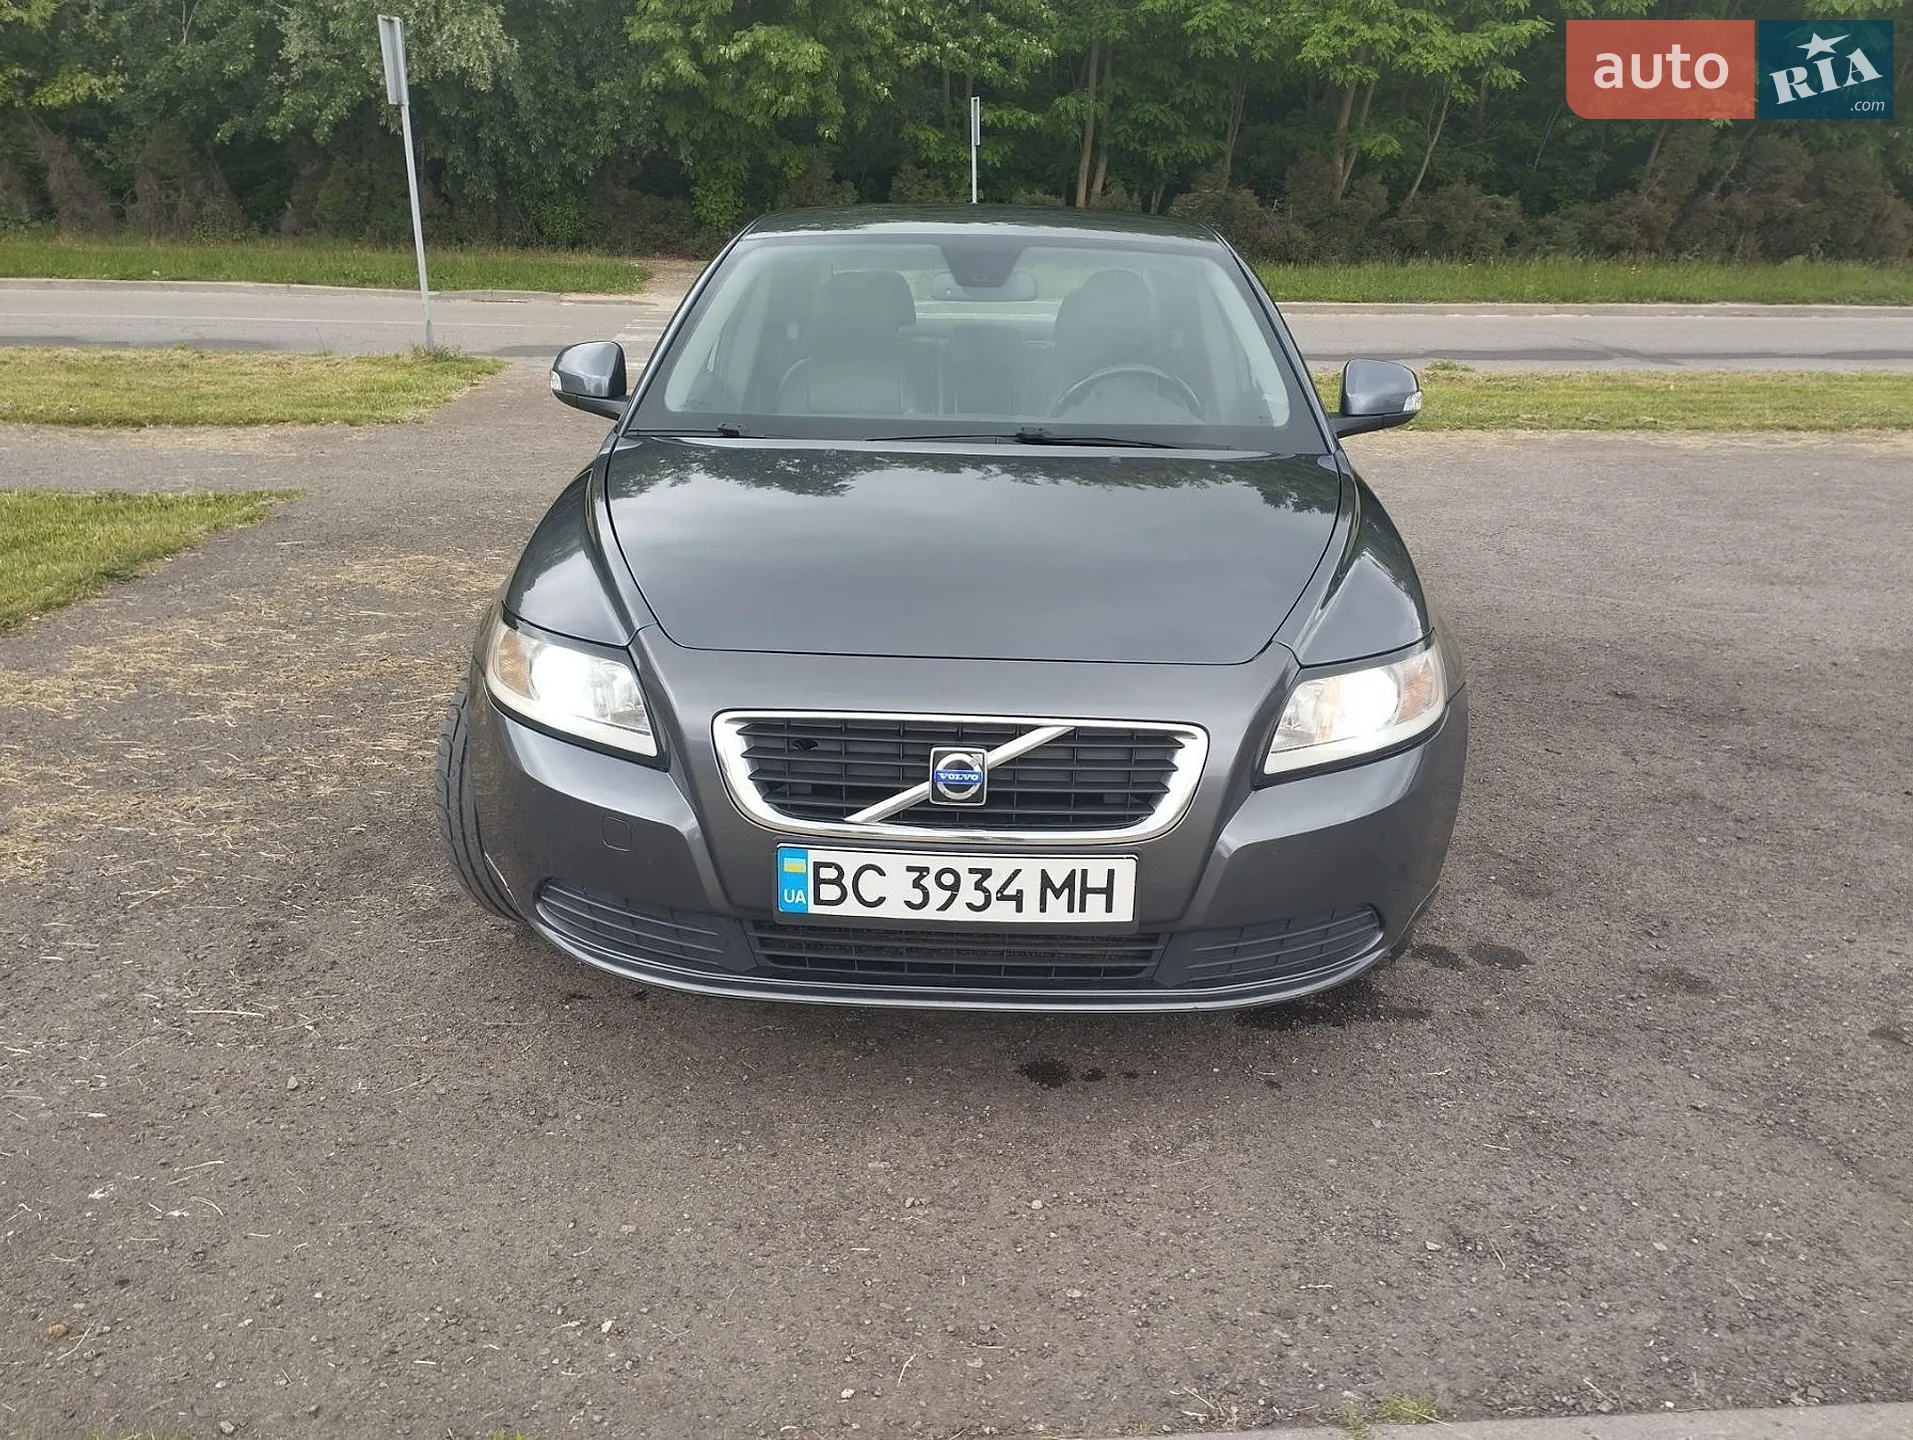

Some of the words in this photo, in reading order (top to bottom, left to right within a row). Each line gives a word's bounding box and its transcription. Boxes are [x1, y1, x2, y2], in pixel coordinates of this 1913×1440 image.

[938, 773, 979, 781] VOLVO
[812, 860, 887, 908] BC
[903, 865, 1024, 914] 3934
[1038, 868, 1116, 914] MH
[783, 888, 807, 905] UA
